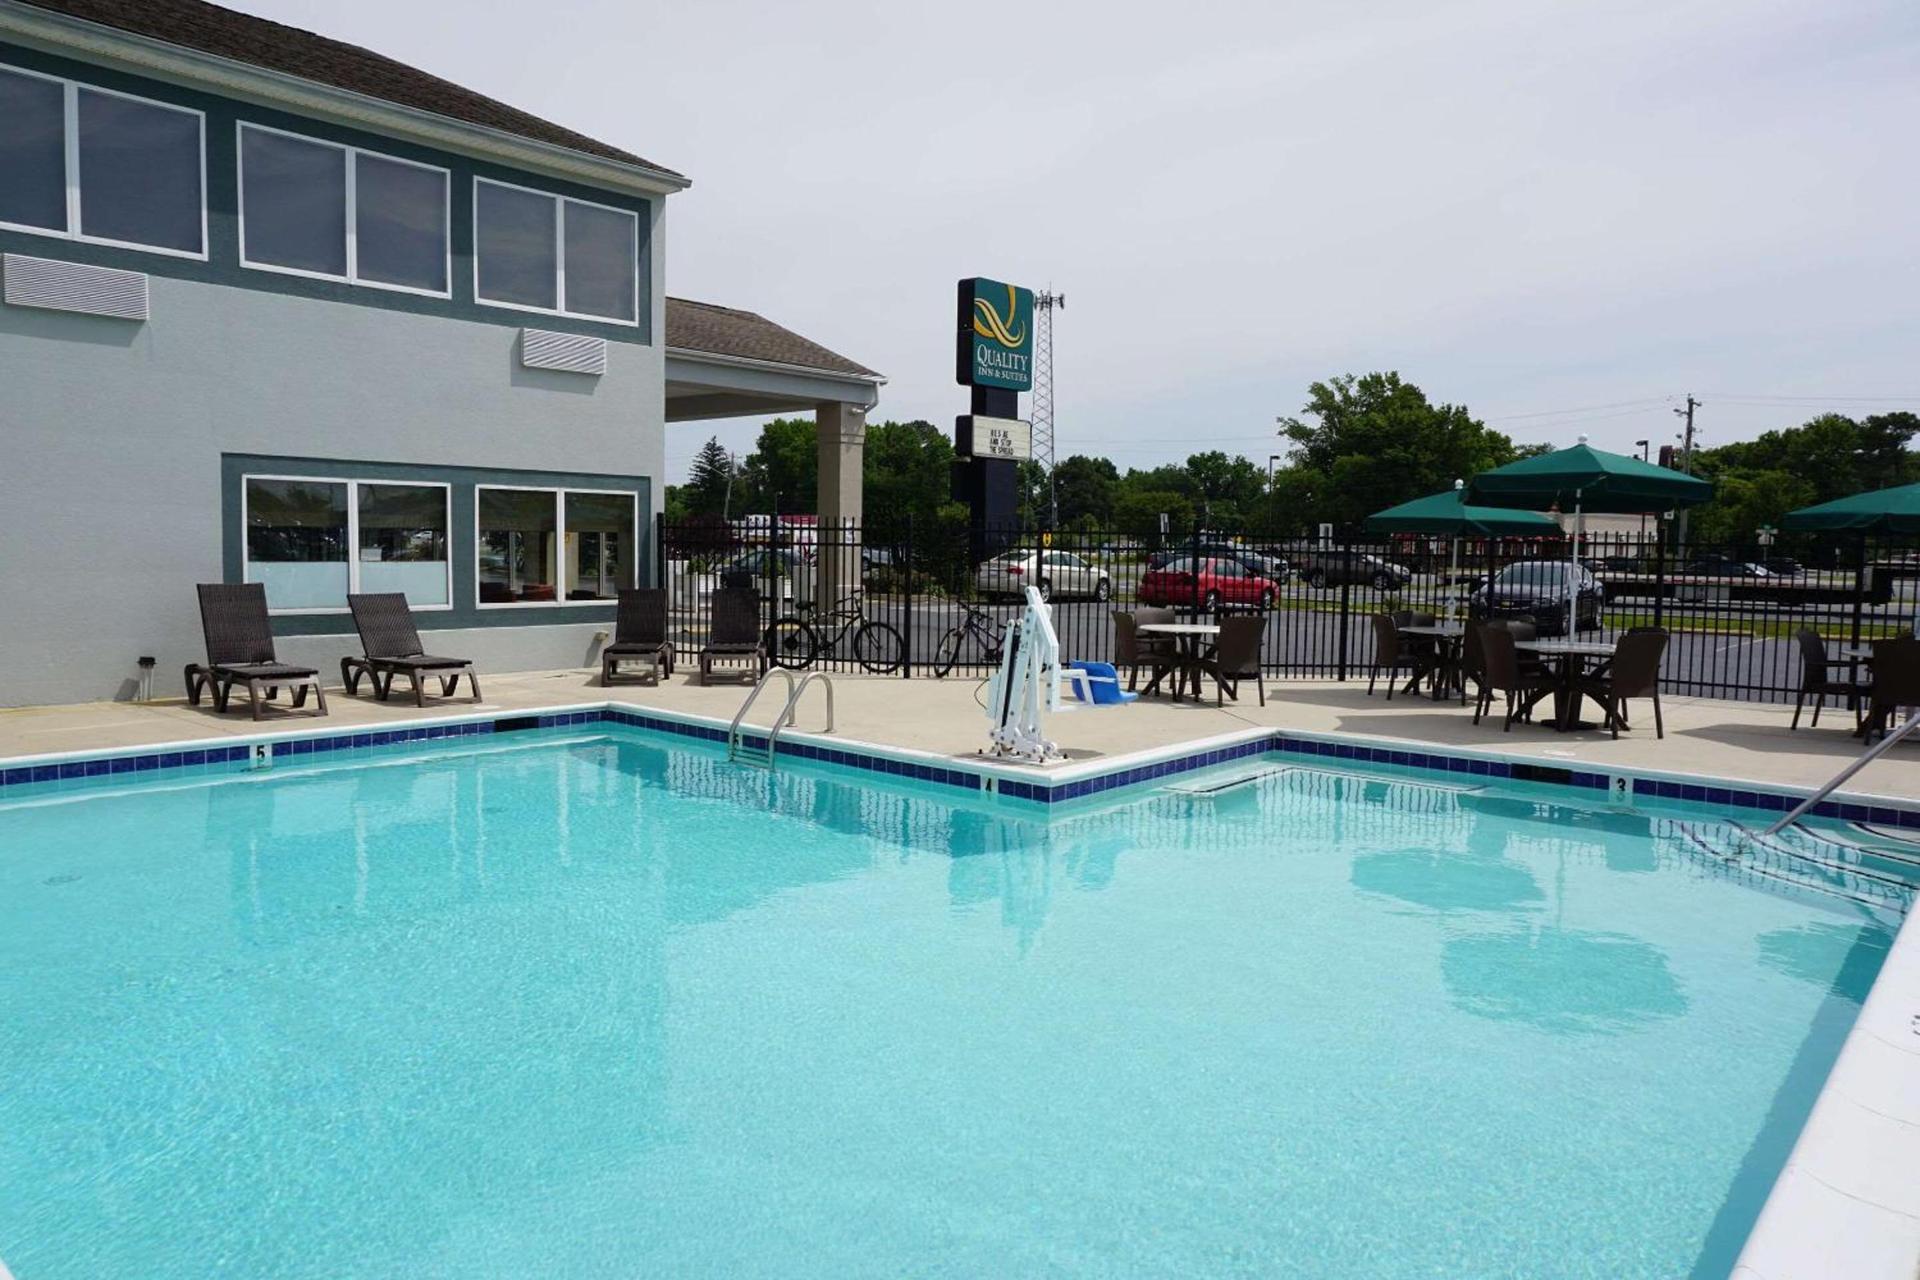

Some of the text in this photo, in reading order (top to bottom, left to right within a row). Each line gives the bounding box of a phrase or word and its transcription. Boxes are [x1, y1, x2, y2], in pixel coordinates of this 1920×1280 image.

[977, 344, 1028, 371] QUALITY
[978, 366, 1028, 382] INN & SUITES
[256, 744, 266, 759] 5
[985, 777, 992, 792] 4
[1616, 777, 1627, 792] 3
